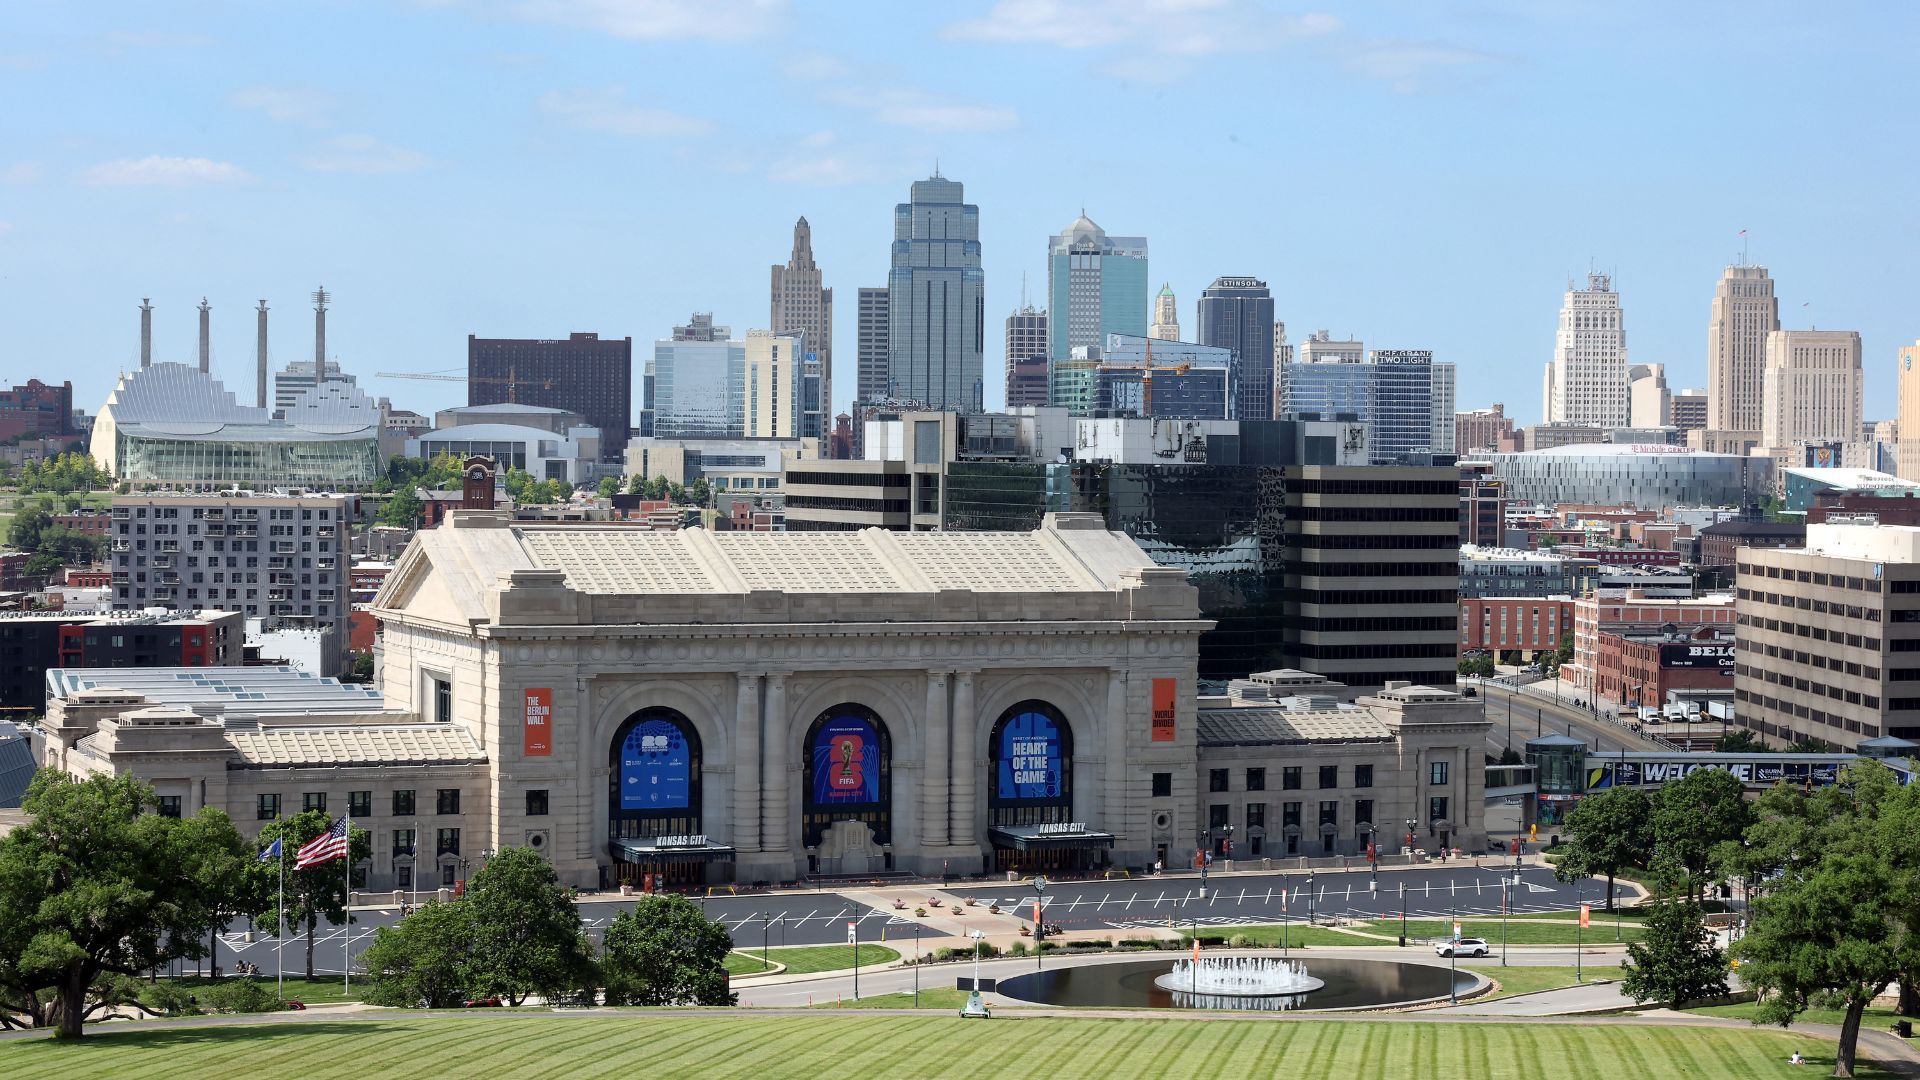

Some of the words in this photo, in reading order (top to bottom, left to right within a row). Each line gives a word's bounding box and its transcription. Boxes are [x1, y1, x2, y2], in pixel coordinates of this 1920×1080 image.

[1379, 356, 1401, 364] TWO
[1402, 356, 1430, 364] LIGHT
[875, 399, 924, 407] PRESIDENT
[527, 696, 539, 706] THE
[1170, 700, 1175, 710] A
[527, 705, 550, 716] BERLIN
[1154, 710, 1175, 719] WORLD
[527, 715, 545, 725] WALL
[1152, 718, 1175, 728] DIVIDED
[1012, 742, 1048, 756] HEART
[1012, 756, 1026, 770] OF
[1028, 756, 1047, 769] THE
[1014, 770, 1046, 784] GAME
[1645, 763, 1751, 782] WELE
[1039, 823, 1068, 834] KANSAS
[1070, 822, 1086, 833] CITY
[656, 835, 688, 847] KANSAS
[690, 834, 707, 845] CITY
